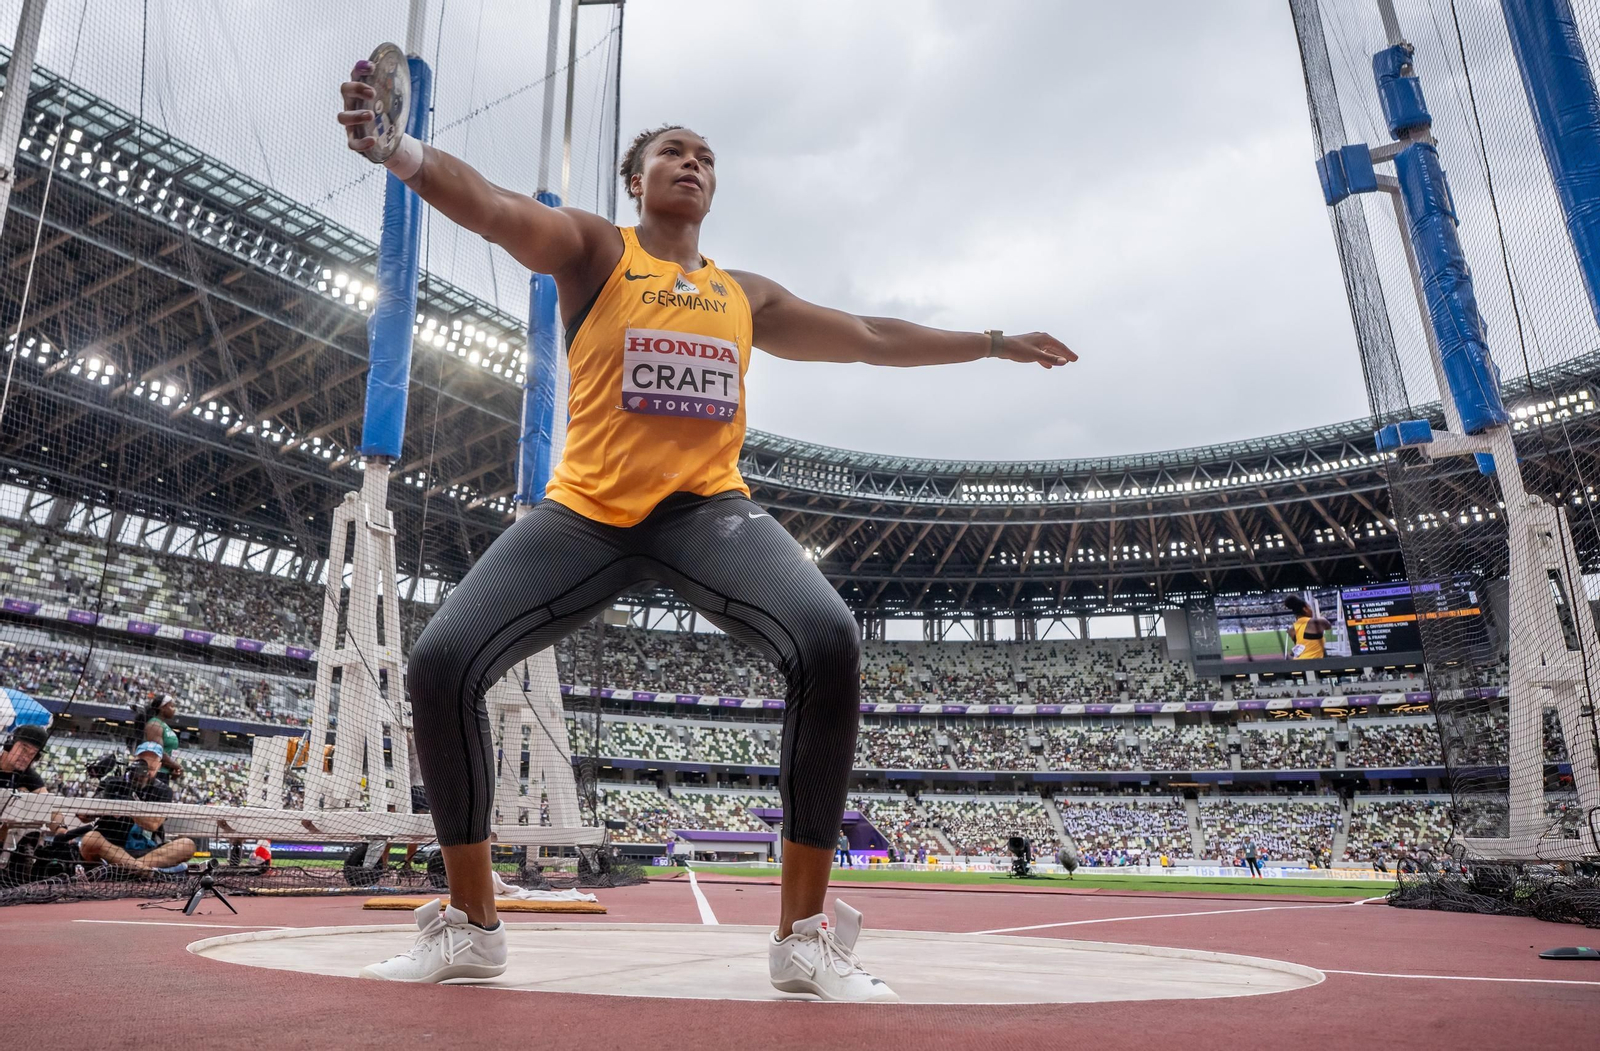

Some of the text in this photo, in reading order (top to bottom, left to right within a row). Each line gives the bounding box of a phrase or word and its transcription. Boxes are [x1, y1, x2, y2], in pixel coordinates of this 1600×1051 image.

[642, 290, 726, 314] GERMANY
[628, 338, 737, 364] HONDA
[632, 364, 733, 396] CRAFT
